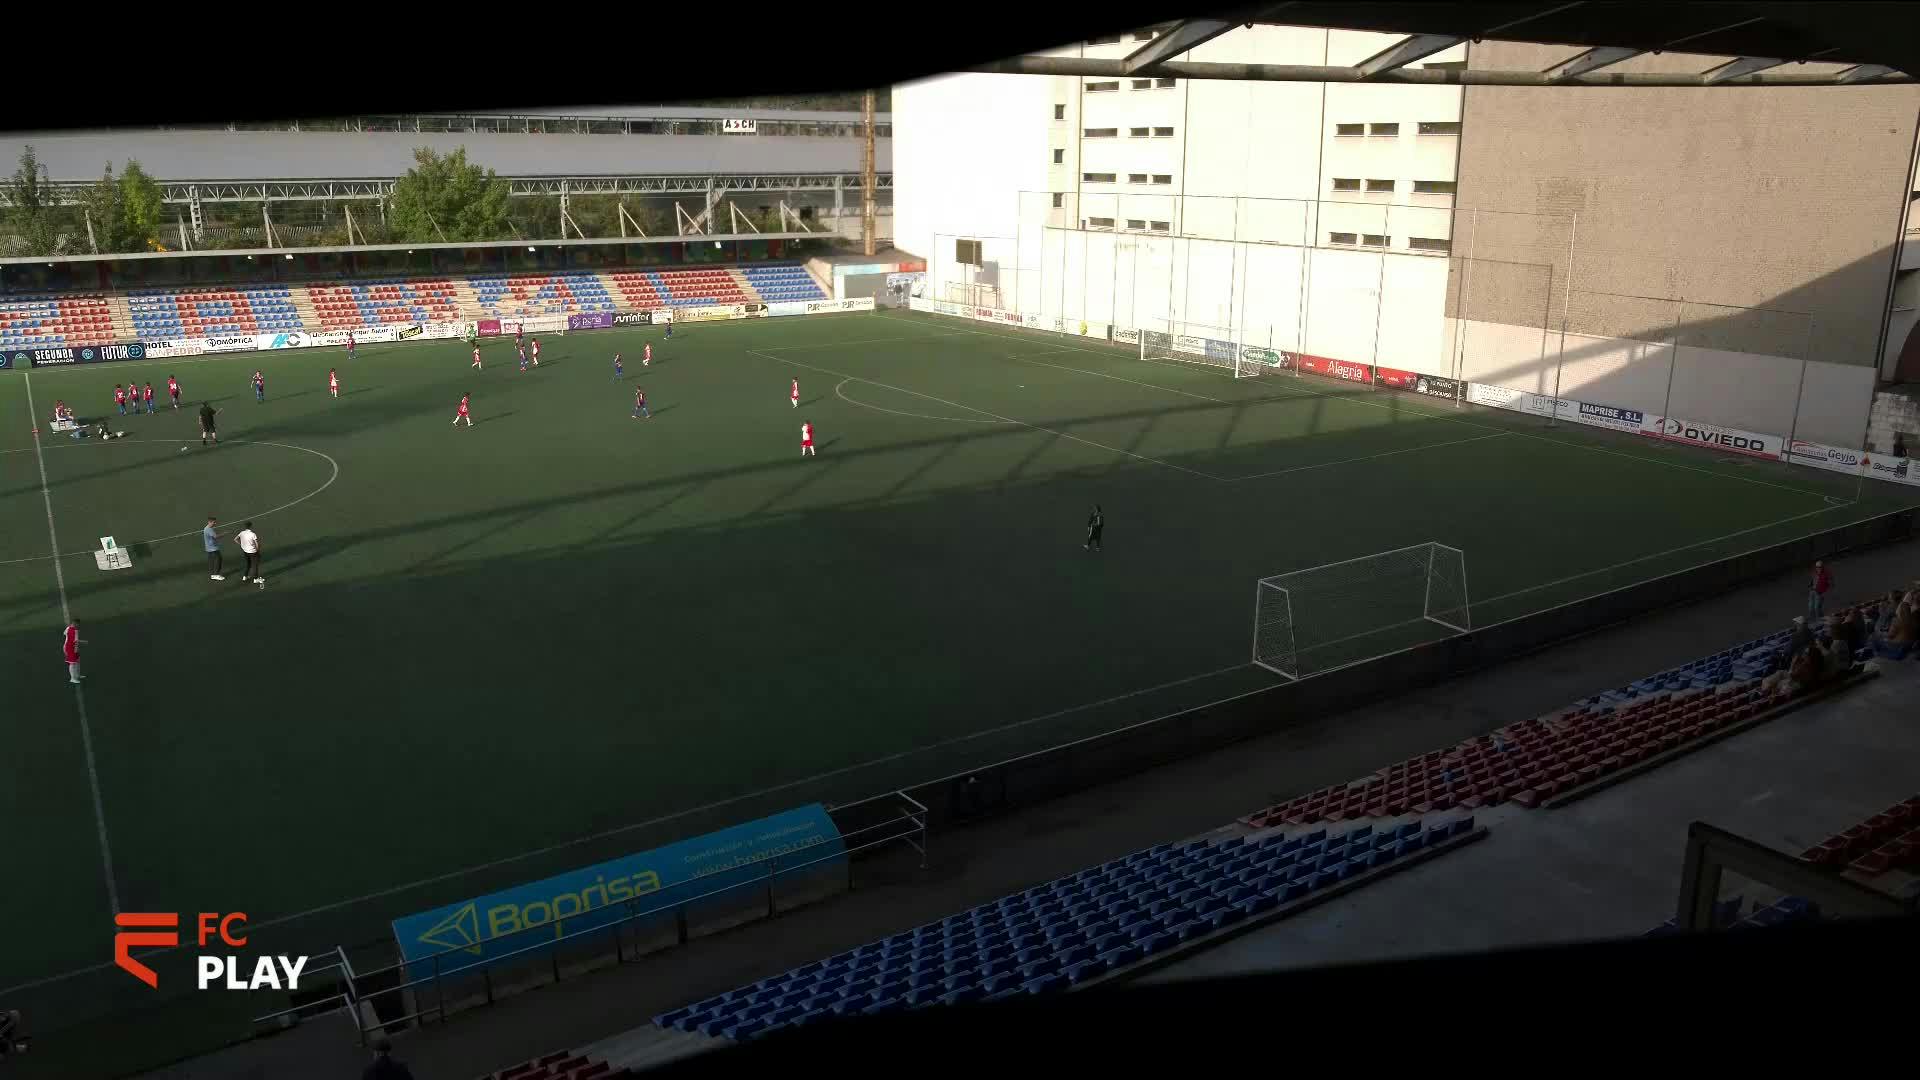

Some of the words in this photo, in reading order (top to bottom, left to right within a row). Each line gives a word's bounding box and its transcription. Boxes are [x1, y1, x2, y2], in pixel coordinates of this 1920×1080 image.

[145, 341, 173, 349] HOTEL
[35, 348, 74, 360] SEGUNDA
[1685, 428, 1765, 452] OVIEDO
[1827, 449, 1856, 463] Geyjo
[487, 869, 662, 939] Boprisa
